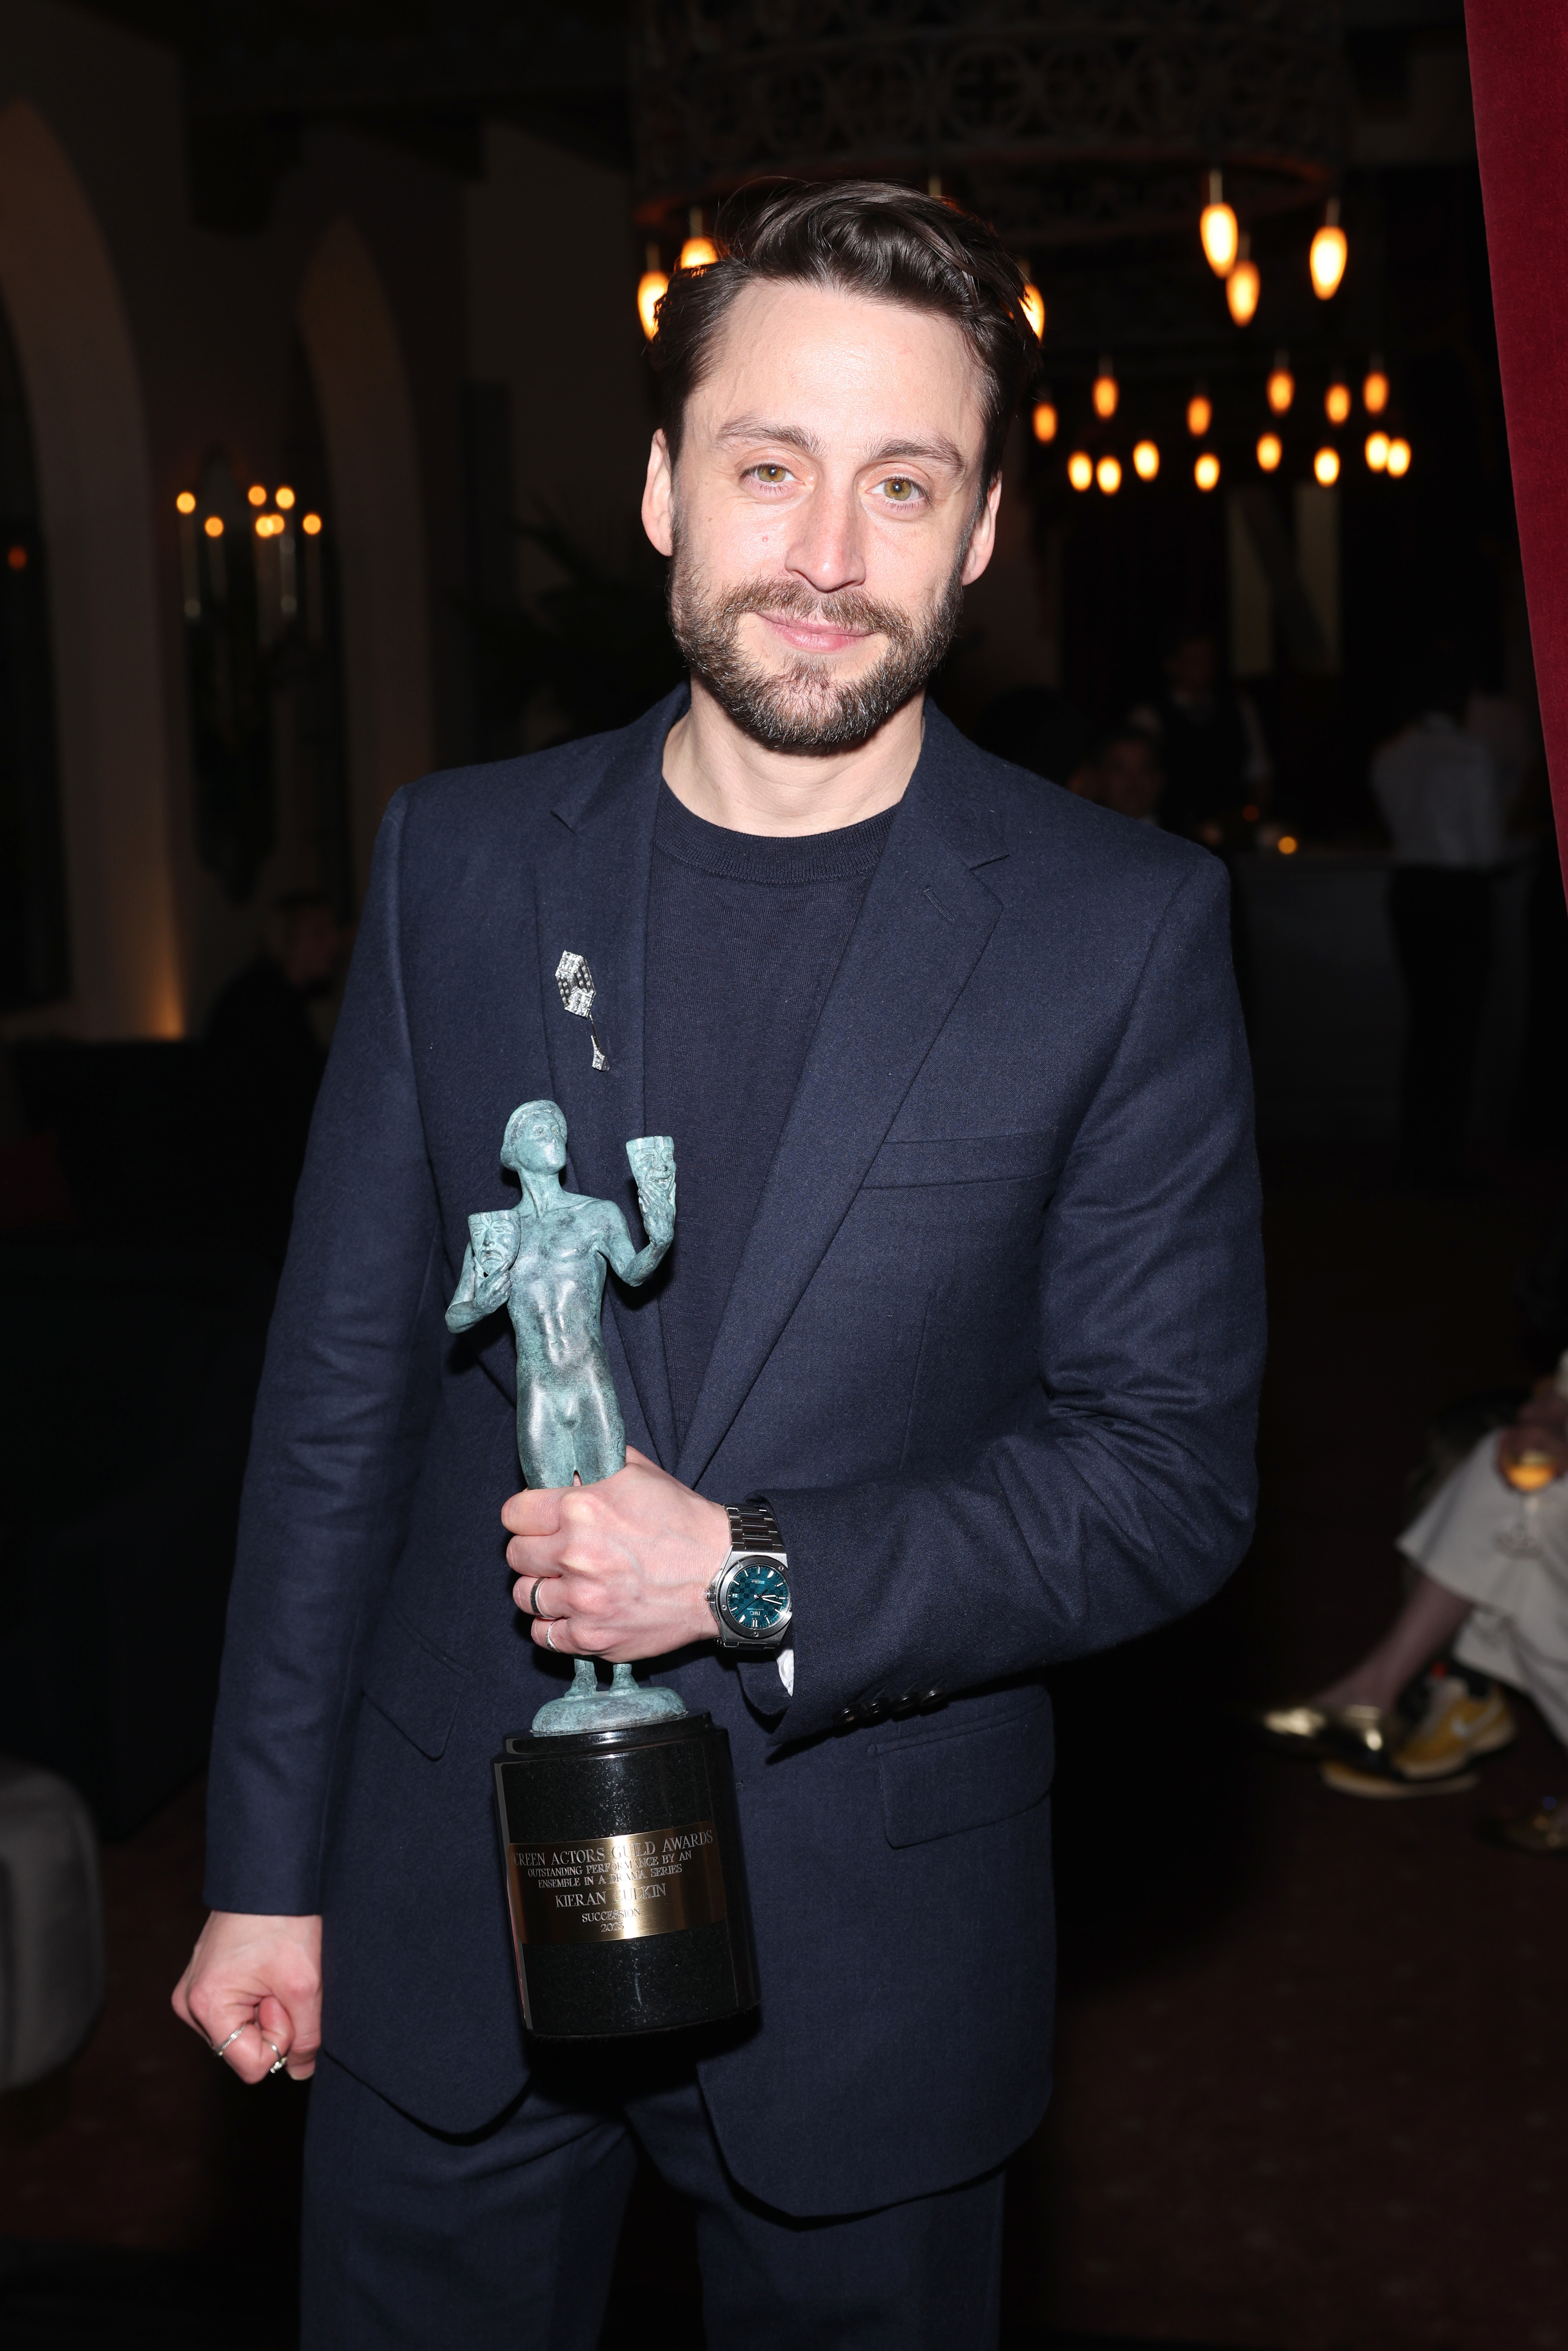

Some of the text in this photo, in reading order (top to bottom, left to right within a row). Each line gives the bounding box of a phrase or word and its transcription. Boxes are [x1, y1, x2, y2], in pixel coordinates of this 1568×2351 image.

[551, 1847, 605, 1865] ACTORS
[611, 1841, 655, 1859] GUILD
[662, 1830, 713, 1852] AWARDS
[528, 1850, 691, 1877] OUTSTANDING PERFORMANCE BY AN
[538, 1864, 683, 1888] ENSEMBLE IN A DRAMA SERIES
[555, 1883, 666, 1908] KIERAN CULKIN
[582, 1908, 641, 1922] SUCCESSION
[600, 1922, 624, 1932] 2023
